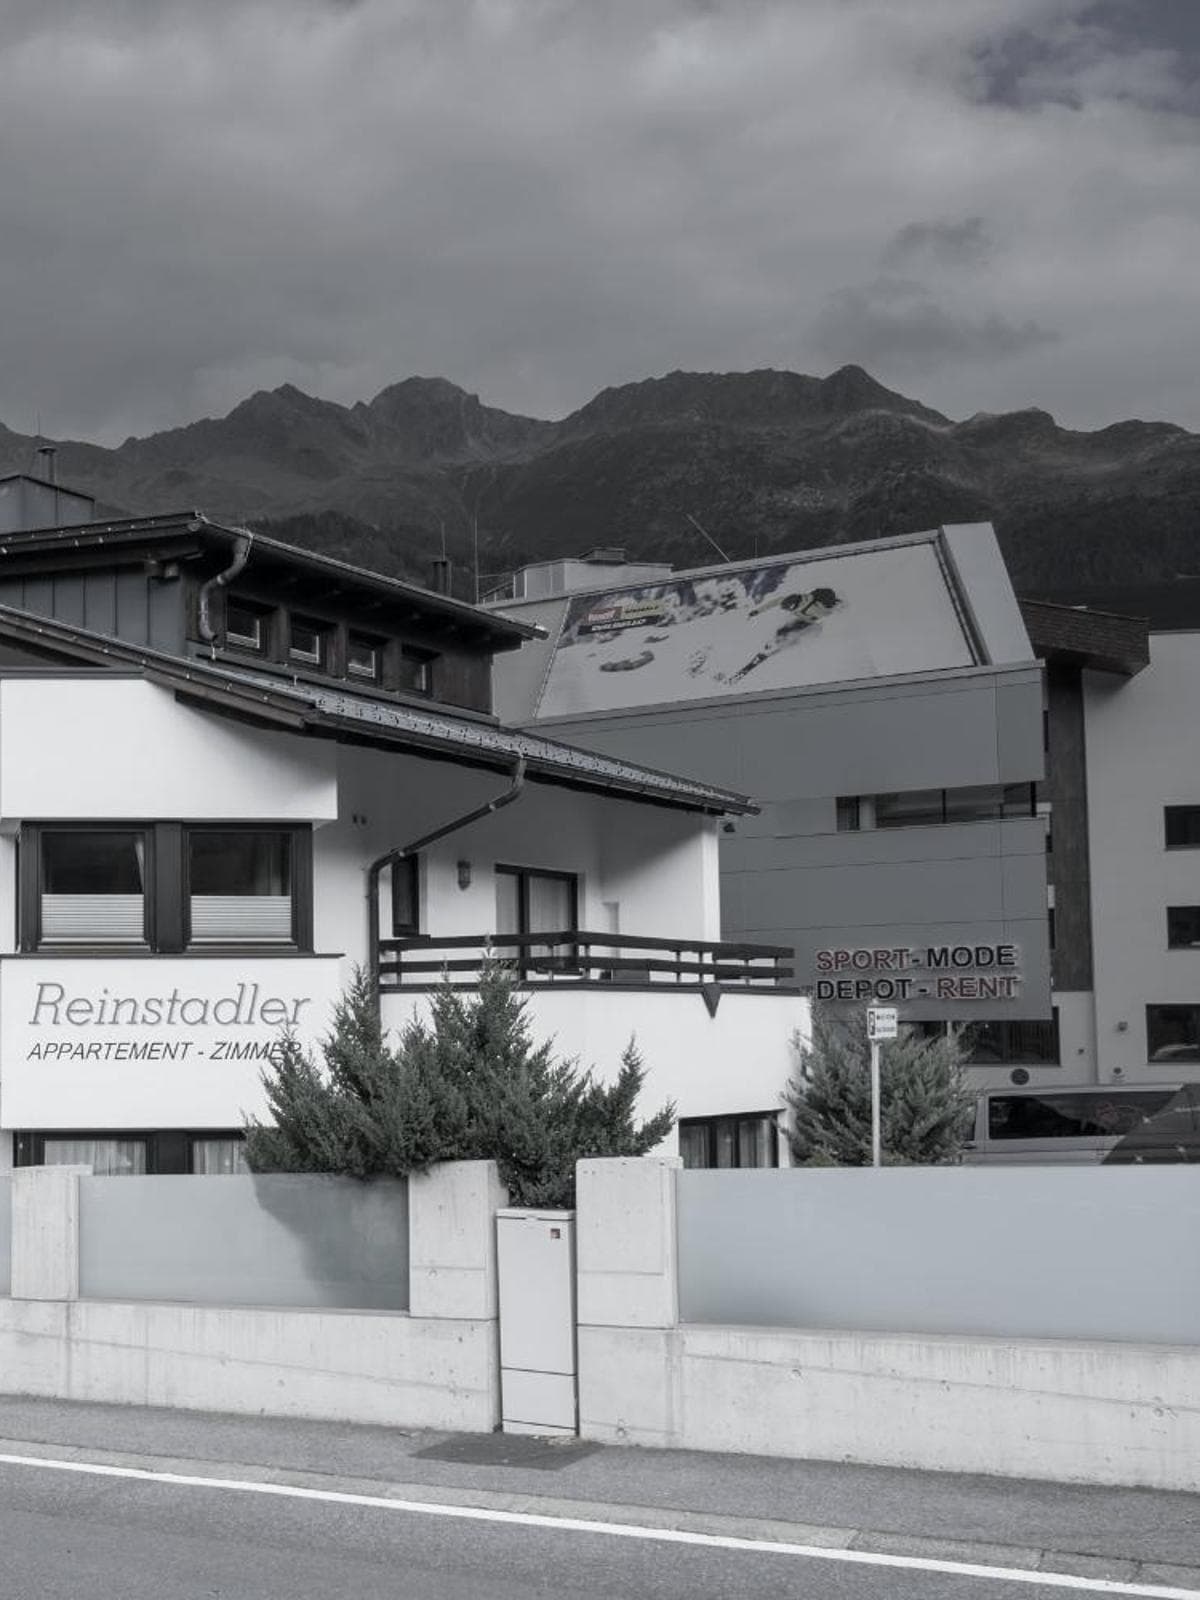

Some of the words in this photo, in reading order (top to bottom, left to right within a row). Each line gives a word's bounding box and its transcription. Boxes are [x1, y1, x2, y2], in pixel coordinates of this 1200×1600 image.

[816, 949, 910, 971] SPORT
[927, 945, 1016, 968] MODE
[816, 978, 913, 1000] DEPOT
[936, 976, 1018, 998] RENT
[28, 982, 311, 1026] Reinstadler
[26, 1041, 193, 1061] APPARTEMENT
